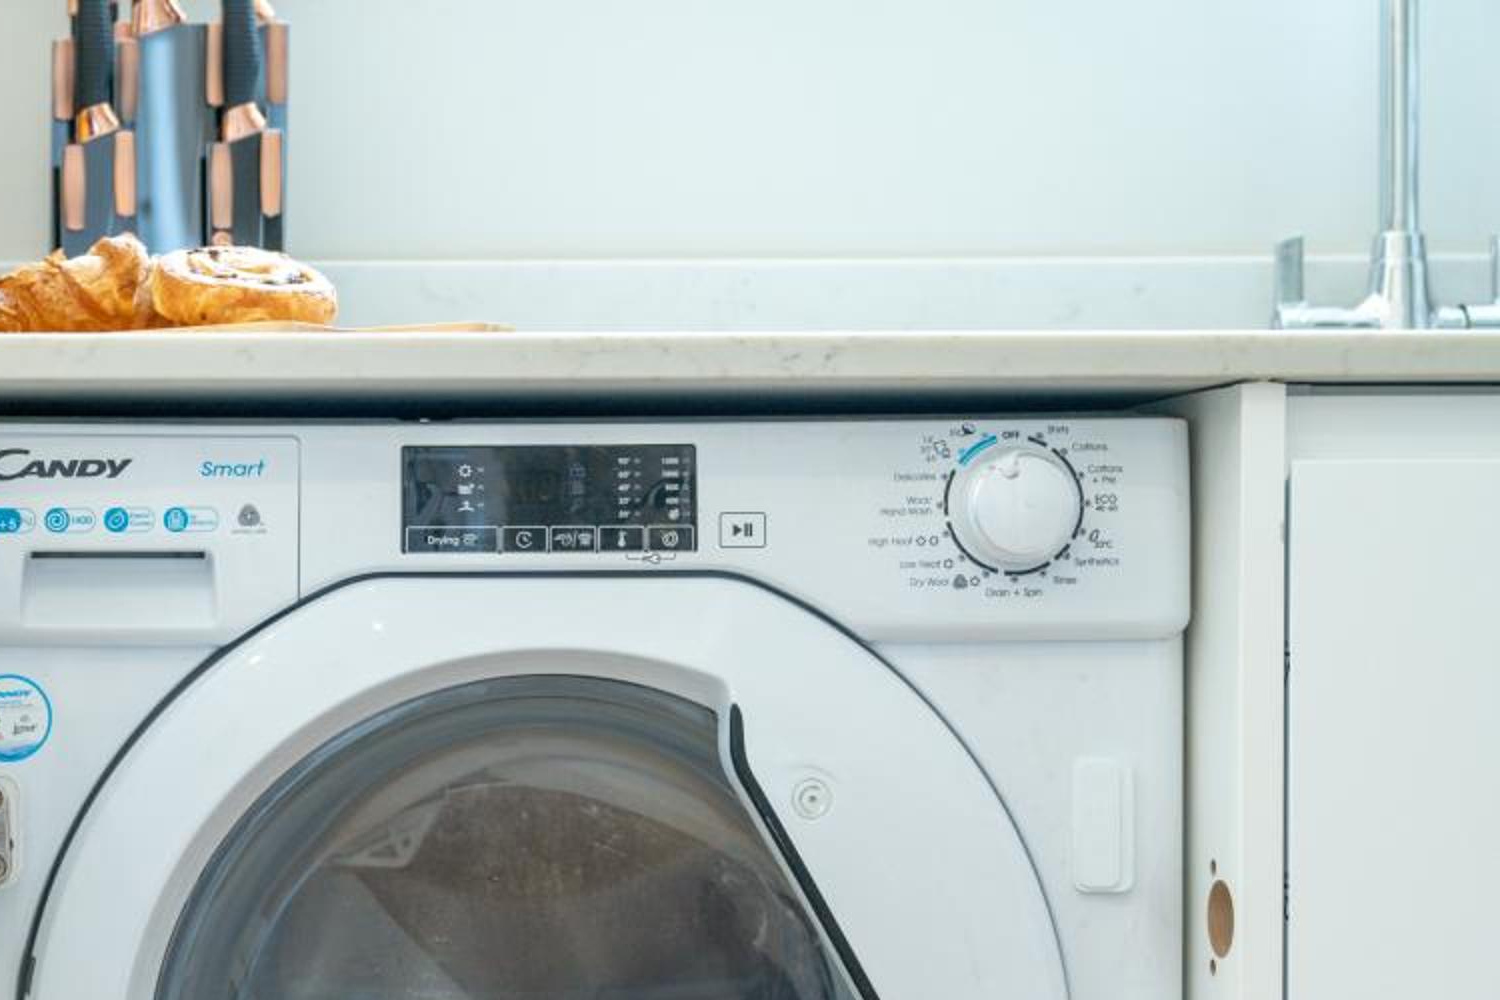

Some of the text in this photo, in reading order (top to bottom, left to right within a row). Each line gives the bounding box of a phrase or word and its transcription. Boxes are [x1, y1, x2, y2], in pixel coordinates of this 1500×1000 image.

[1001, 430, 1020, 440] OFF
[1071, 441, 1109, 452] Cottons
[200, 457, 266, 478] Smart
[1087, 463, 1124, 473] Cottons
[1094, 493, 1118, 505] ECO
[427, 534, 461, 547] Drying
[1023, 586, 1044, 598] Spin
